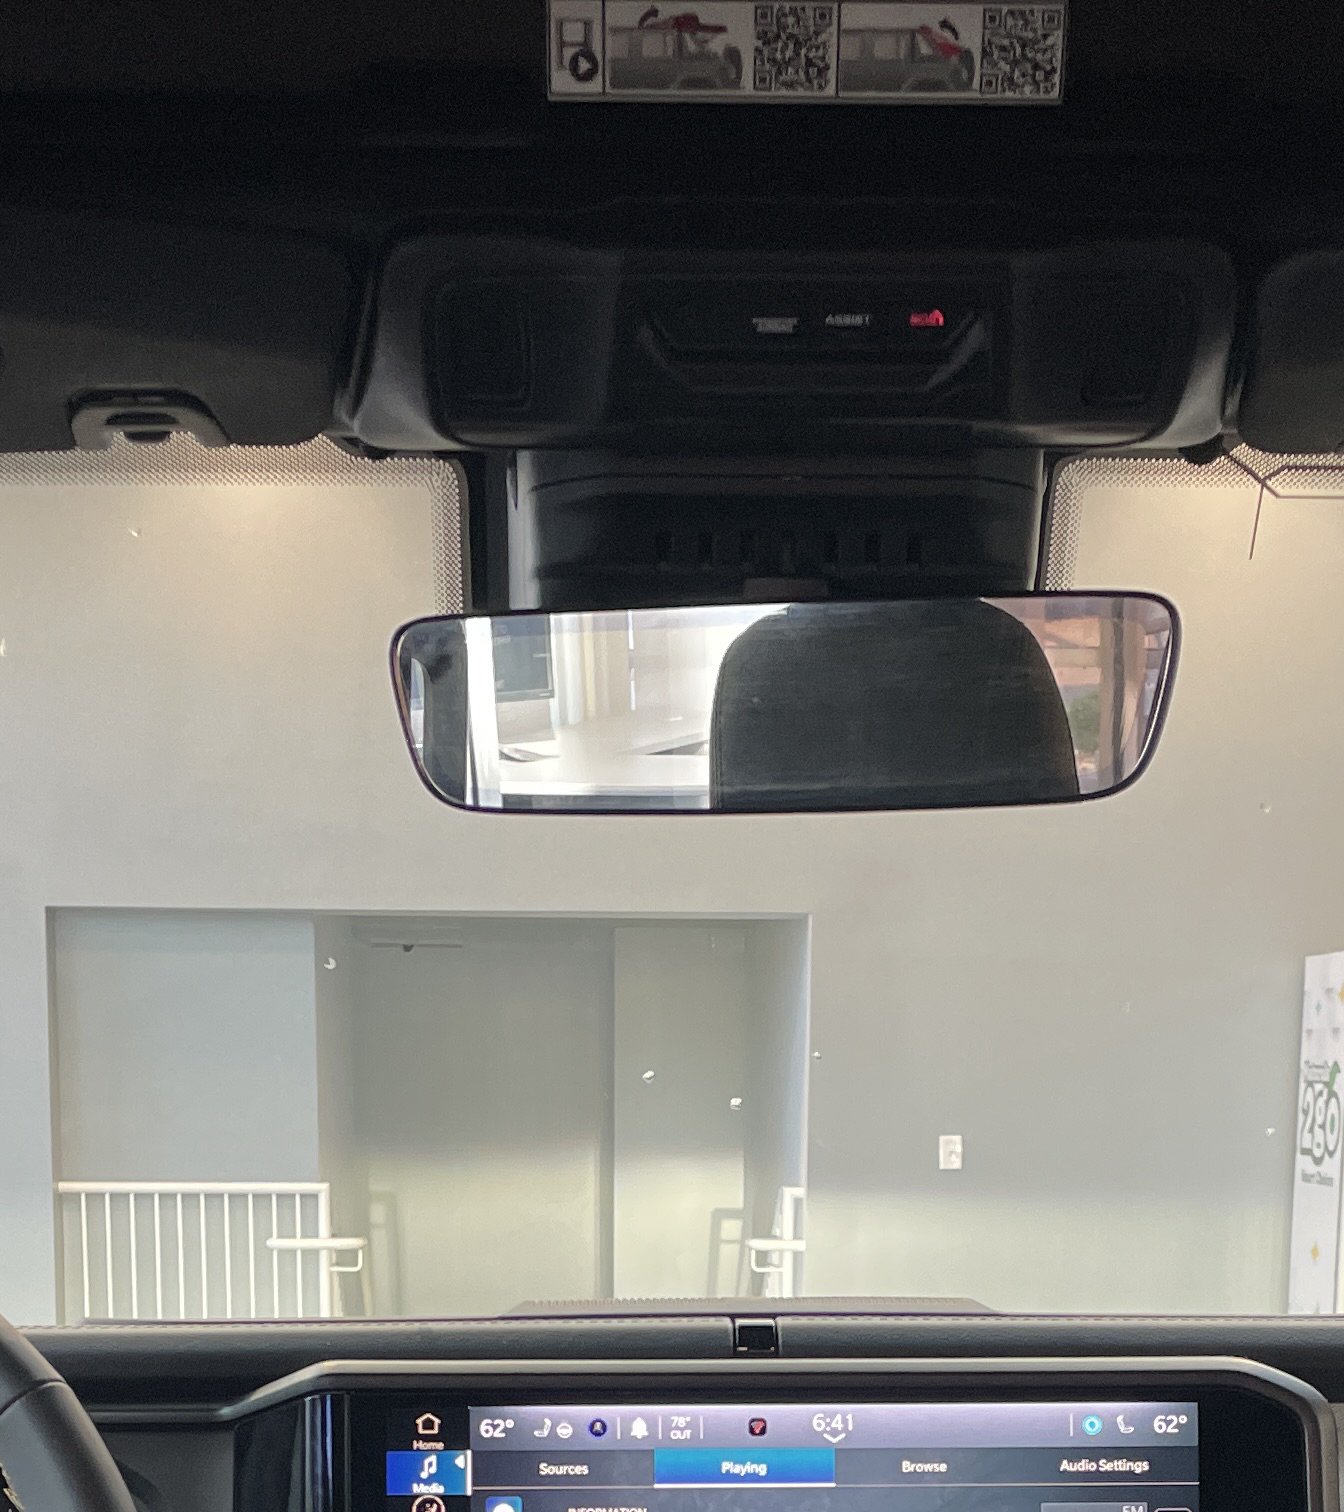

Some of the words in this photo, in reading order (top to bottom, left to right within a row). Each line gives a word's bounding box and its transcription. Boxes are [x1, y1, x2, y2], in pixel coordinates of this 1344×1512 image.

[479, 1418, 514, 1438] 62°
[670, 1416, 691, 1428] 78°
[812, 1413, 854, 1431] 6:41
[1153, 1415, 1188, 1433] 62°
[670, 1430, 692, 1440] OUT
[413, 1440, 444, 1450] Home
[539, 1463, 589, 1475] Sources
[721, 1462, 767, 1476] Playing
[902, 1460, 948, 1473] Browse
[1059, 1459, 1097, 1472] Audio
[1099, 1459, 1149, 1475] Settings
[412, 1483, 445, 1494] Media
